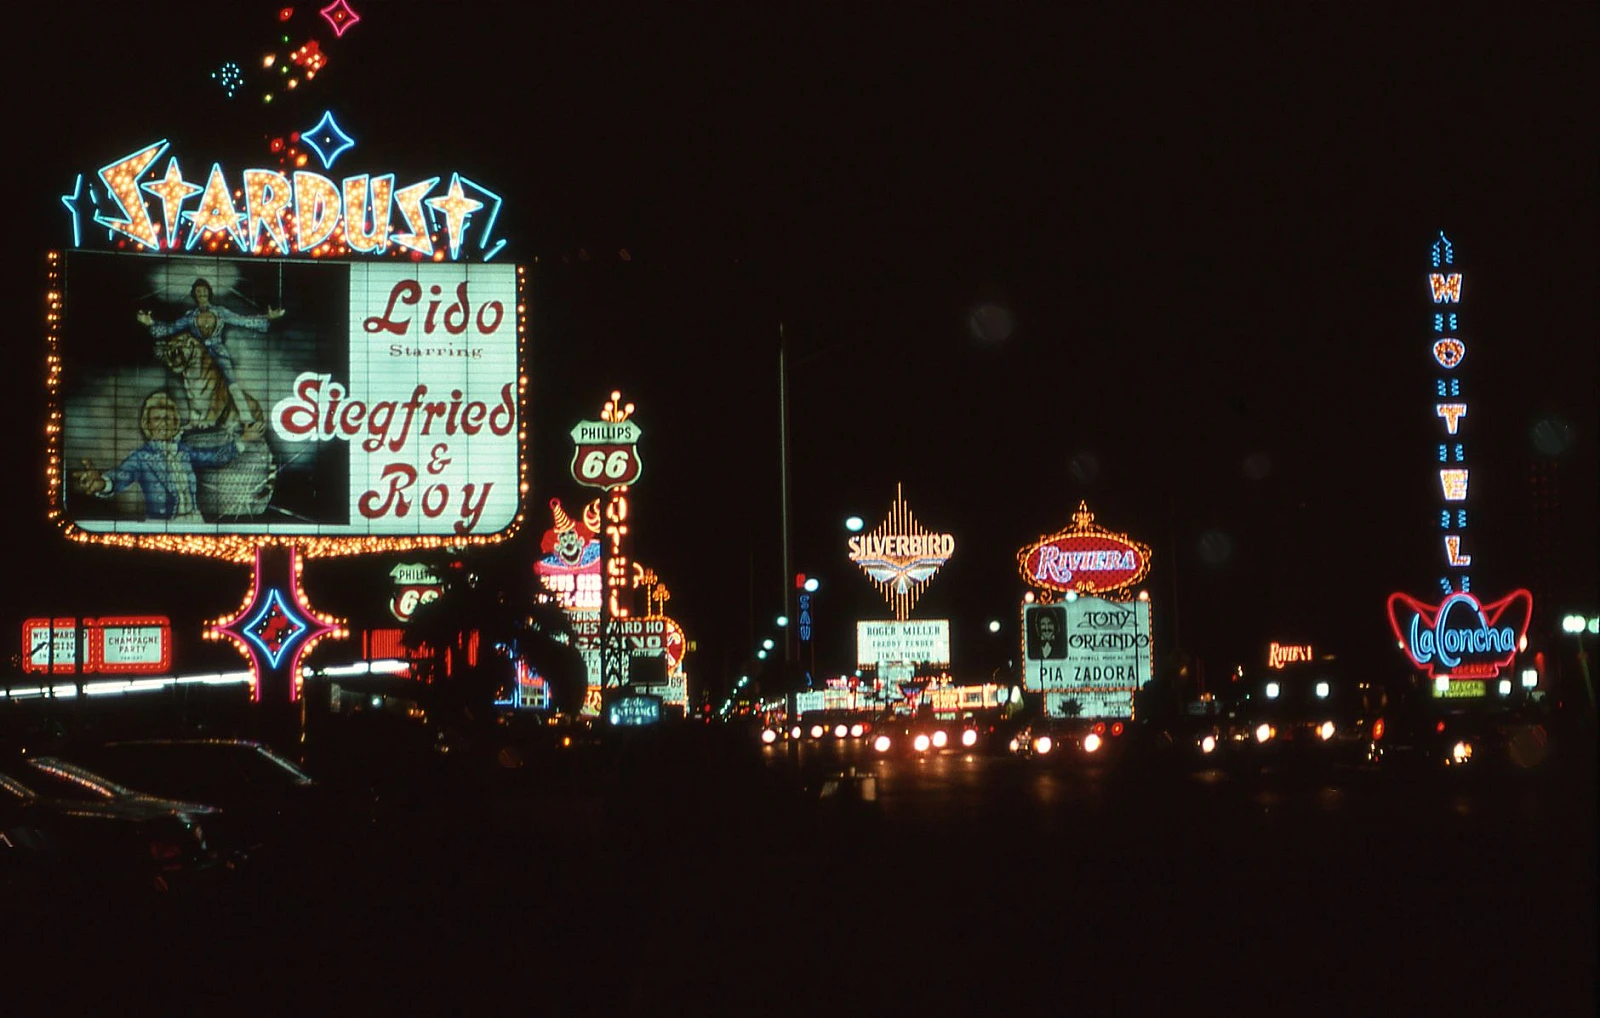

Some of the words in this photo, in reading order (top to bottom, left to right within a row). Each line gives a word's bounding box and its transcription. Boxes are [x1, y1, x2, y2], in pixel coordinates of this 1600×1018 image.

[97, 138, 485, 260] STARDUST
[362, 279, 504, 335] Lido
[389, 343, 484, 359] Starring
[280, 382, 516, 453] Siegfried
[1429, 273, 1472, 567] MOTEL
[581, 427, 632, 440] PHILLIPS
[427, 443, 452, 475] &
[582, 450, 629, 479] 66
[358, 462, 495, 534] Roy
[848, 533, 955, 559] SILVERBIRD
[1035, 545, 1136, 583] RIVIERA
[646, 621, 664, 633] HO
[867, 626, 896, 636] ROGER
[903, 626, 940, 636] MILLER
[1083, 611, 1131, 629] TONY
[1436, 594, 1516, 667] Concha
[108, 636, 158, 646] CHAMPAGNE
[119, 646, 146, 654] PARTY
[1069, 633, 1150, 651] ORLANDO
[1040, 667, 1063, 681] PIA
[1074, 666, 1136, 681] ZADORA
